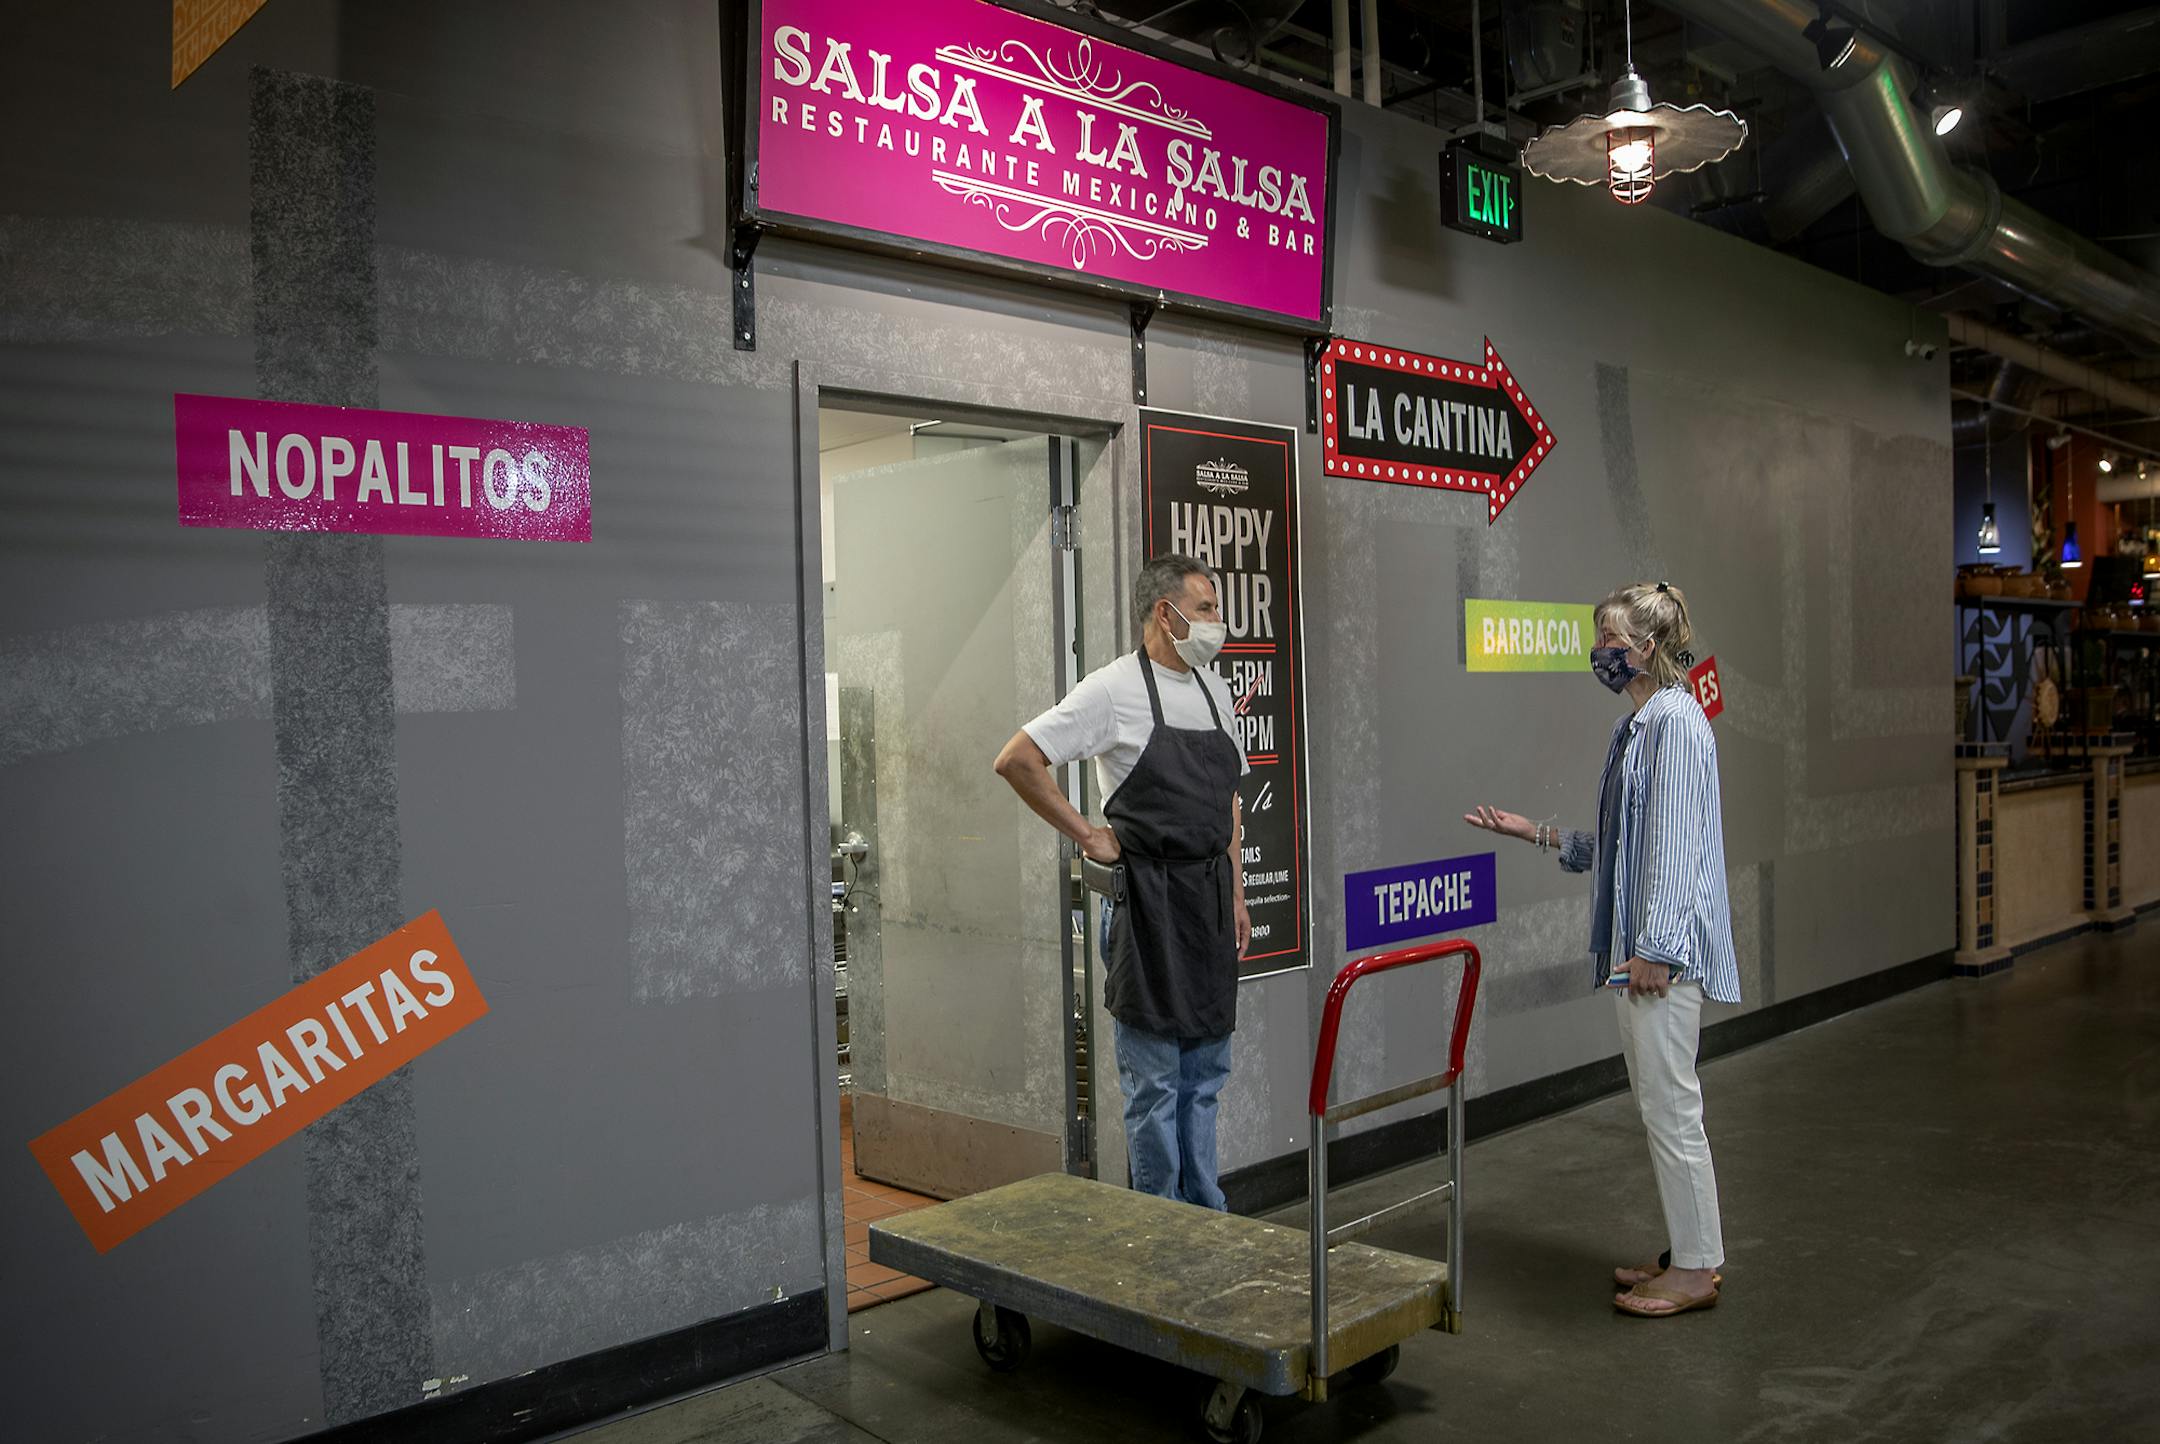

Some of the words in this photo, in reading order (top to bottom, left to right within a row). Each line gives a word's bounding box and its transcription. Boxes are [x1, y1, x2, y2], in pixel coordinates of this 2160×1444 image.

[773, 25, 991, 137] SALSA
[1009, 94, 1056, 155] A
[1077, 110, 1148, 178] LA
[1167, 138, 1316, 225] SALSA
[773, 95, 1041, 188] RESTAURANTE
[1063, 171, 1218, 231] MEXICANO
[1237, 216, 1252, 240] &
[1269, 227, 1316, 258] BAR
[1467, 164, 1511, 230] EXIT
[1347, 383, 1385, 442] LA
[1394, 392, 1513, 460] CANTINA
[228, 429, 552, 513] NOPALITOS
[1170, 501, 1273, 571] HAPPY
[1482, 617, 1582, 656] BARBACOA
[1241, 846, 1262, 864] TAILS
[1374, 870, 1473, 926] TEPACHE
[70, 948, 456, 1213] MARGARITAS
